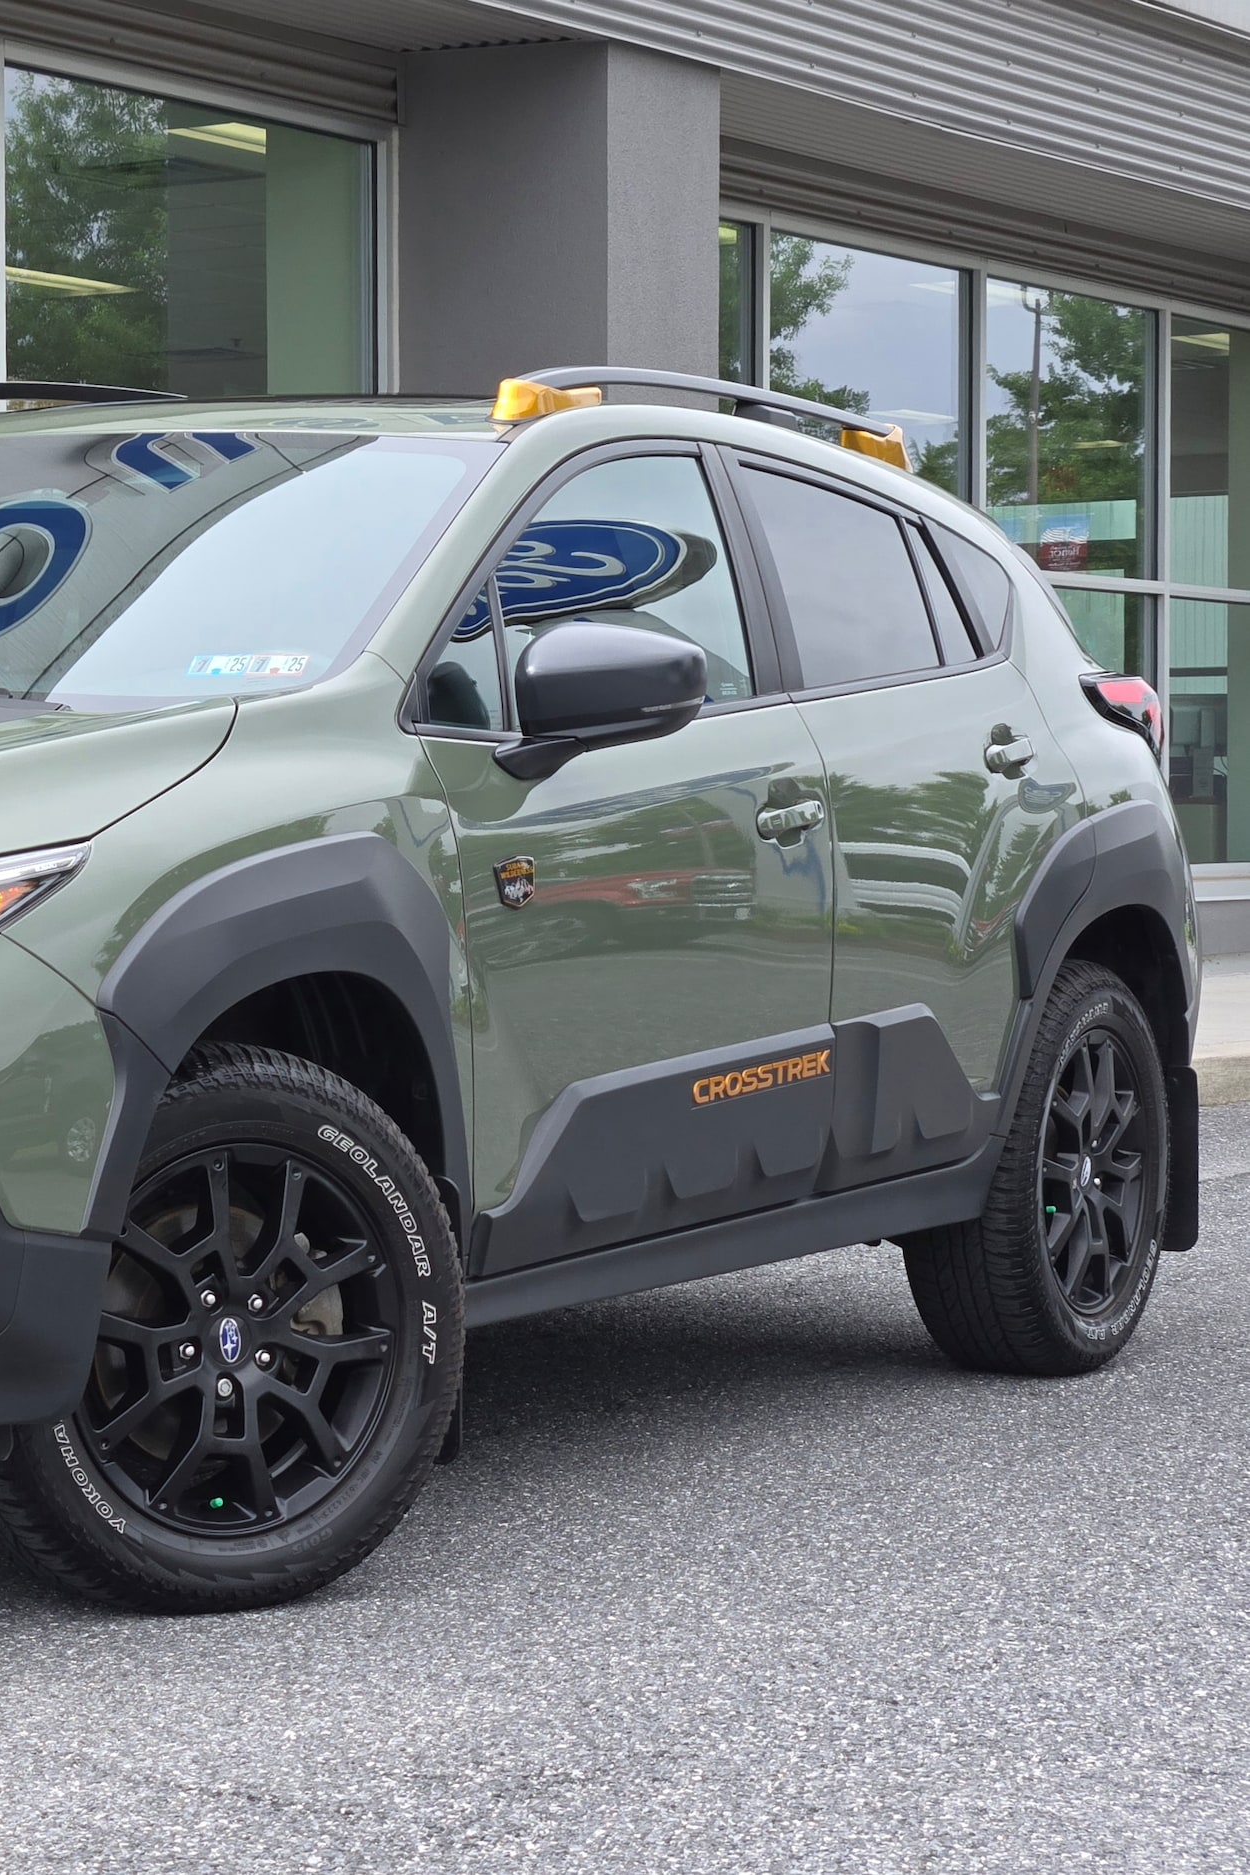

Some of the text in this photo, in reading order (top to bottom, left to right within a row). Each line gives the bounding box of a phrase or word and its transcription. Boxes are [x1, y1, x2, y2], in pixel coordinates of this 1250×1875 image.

[229, 657, 248, 672] 25
[287, 657, 306, 672] 25
[693, 1049, 831, 1104] CROSSTREK
[318, 1124, 437, 1365] GEOLANDAR A/T
[53, 1420, 126, 1534] YOKOHA
